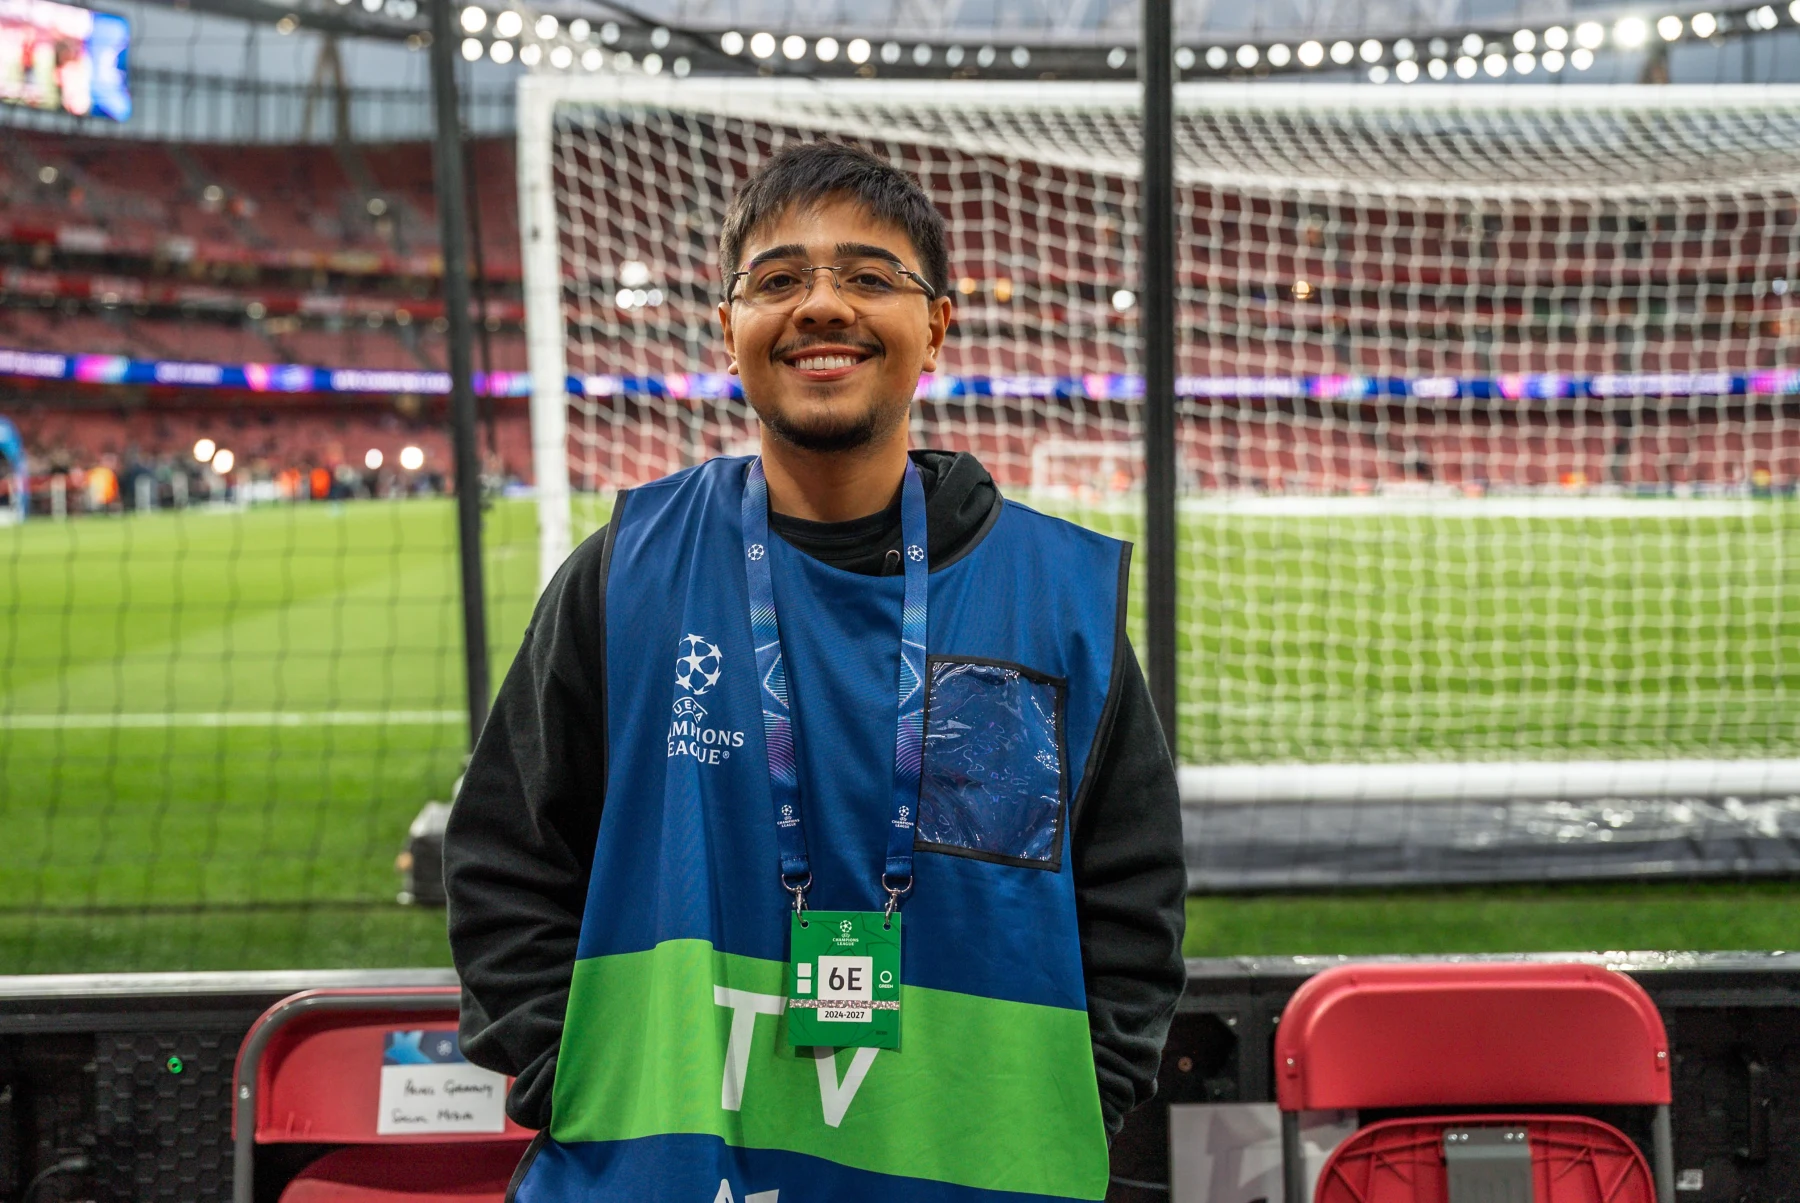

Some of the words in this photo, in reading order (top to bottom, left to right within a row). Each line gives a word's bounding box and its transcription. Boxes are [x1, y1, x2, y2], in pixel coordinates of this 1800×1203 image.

[673, 700, 704, 722] UEFA
[667, 720, 745, 747] MPIONS
[667, 740, 730, 765] EAGUE®
[828, 967, 862, 991] 6E
[824, 1010, 865, 1019] 2024-2027
